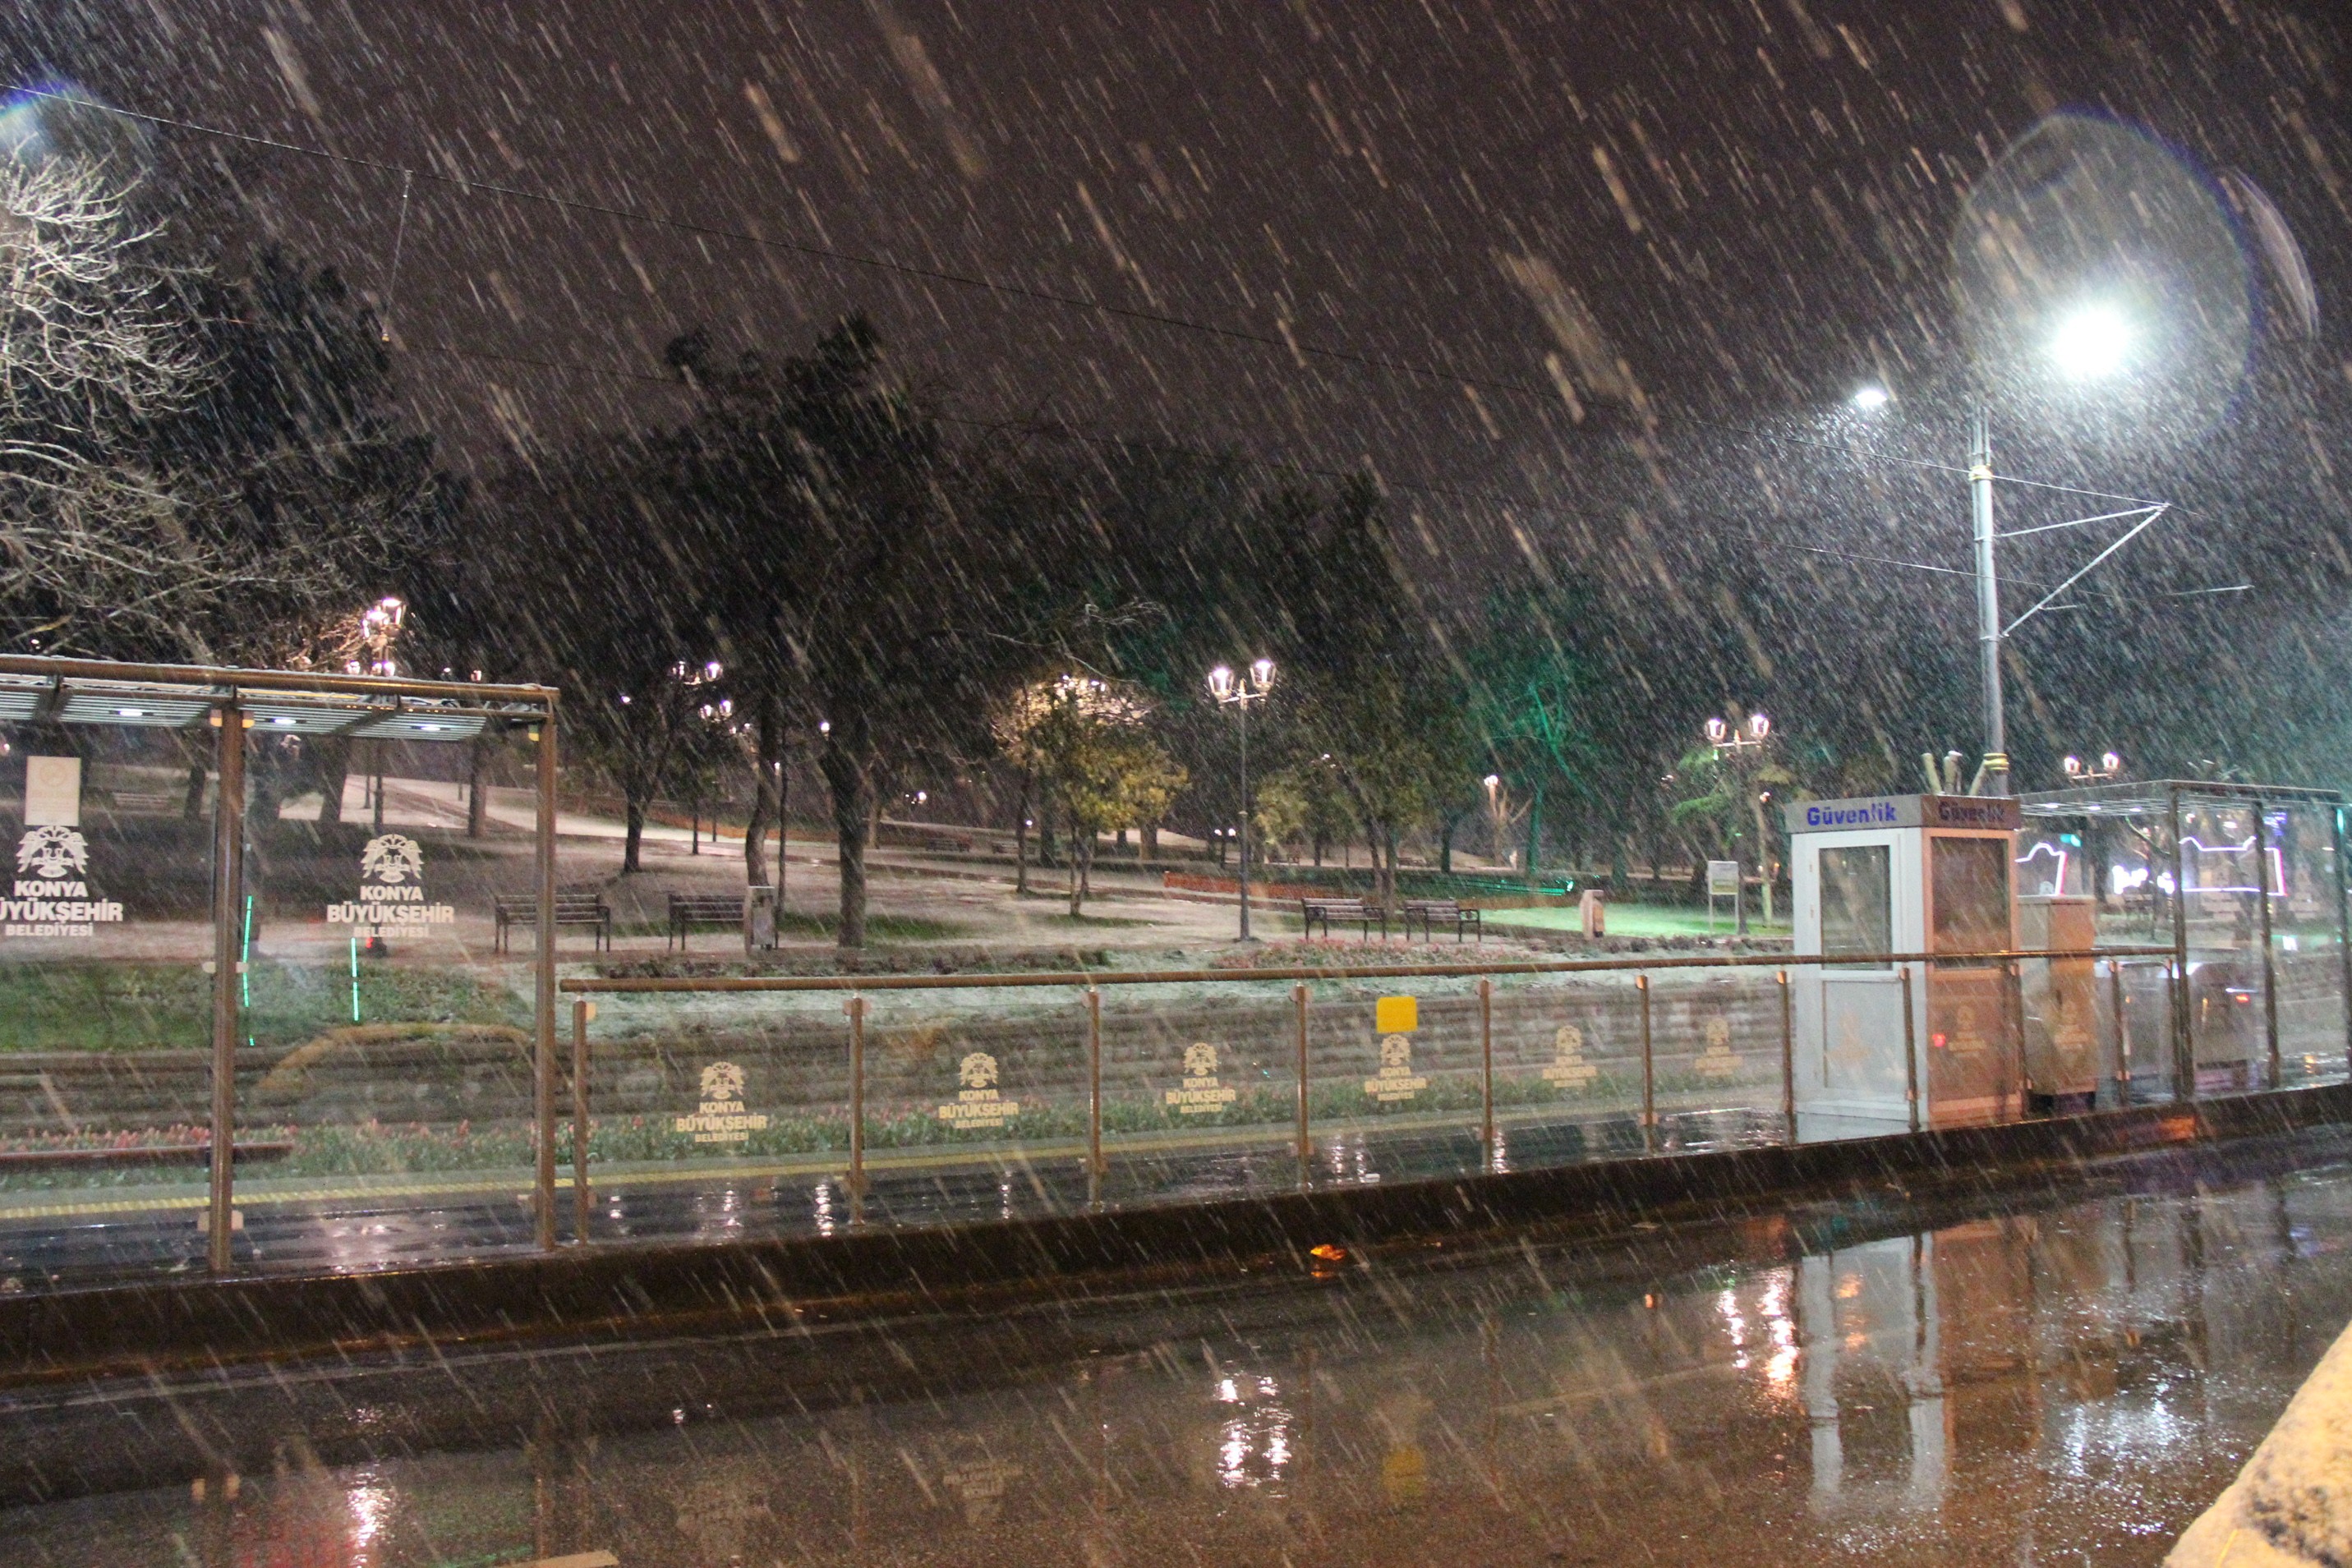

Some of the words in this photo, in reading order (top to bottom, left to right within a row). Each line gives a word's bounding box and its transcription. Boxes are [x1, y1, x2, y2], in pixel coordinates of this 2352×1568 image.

[1807, 802, 1897, 826] Güvenlik
[14, 881, 89, 897] KONYA
[360, 885, 424, 901] KONYA
[327, 901, 454, 925] BÜYÜKŞEHİR
[5, 922, 94, 936] BELEDİYESİ
[353, 925, 430, 938] BELEDİYESİ
[1183, 1077, 1219, 1088] KONYA
[959, 1089, 999, 1101] KONYA
[699, 1101, 745, 1114] KONYA
[676, 1112, 767, 1132] BÜYÜKŞEHİR
